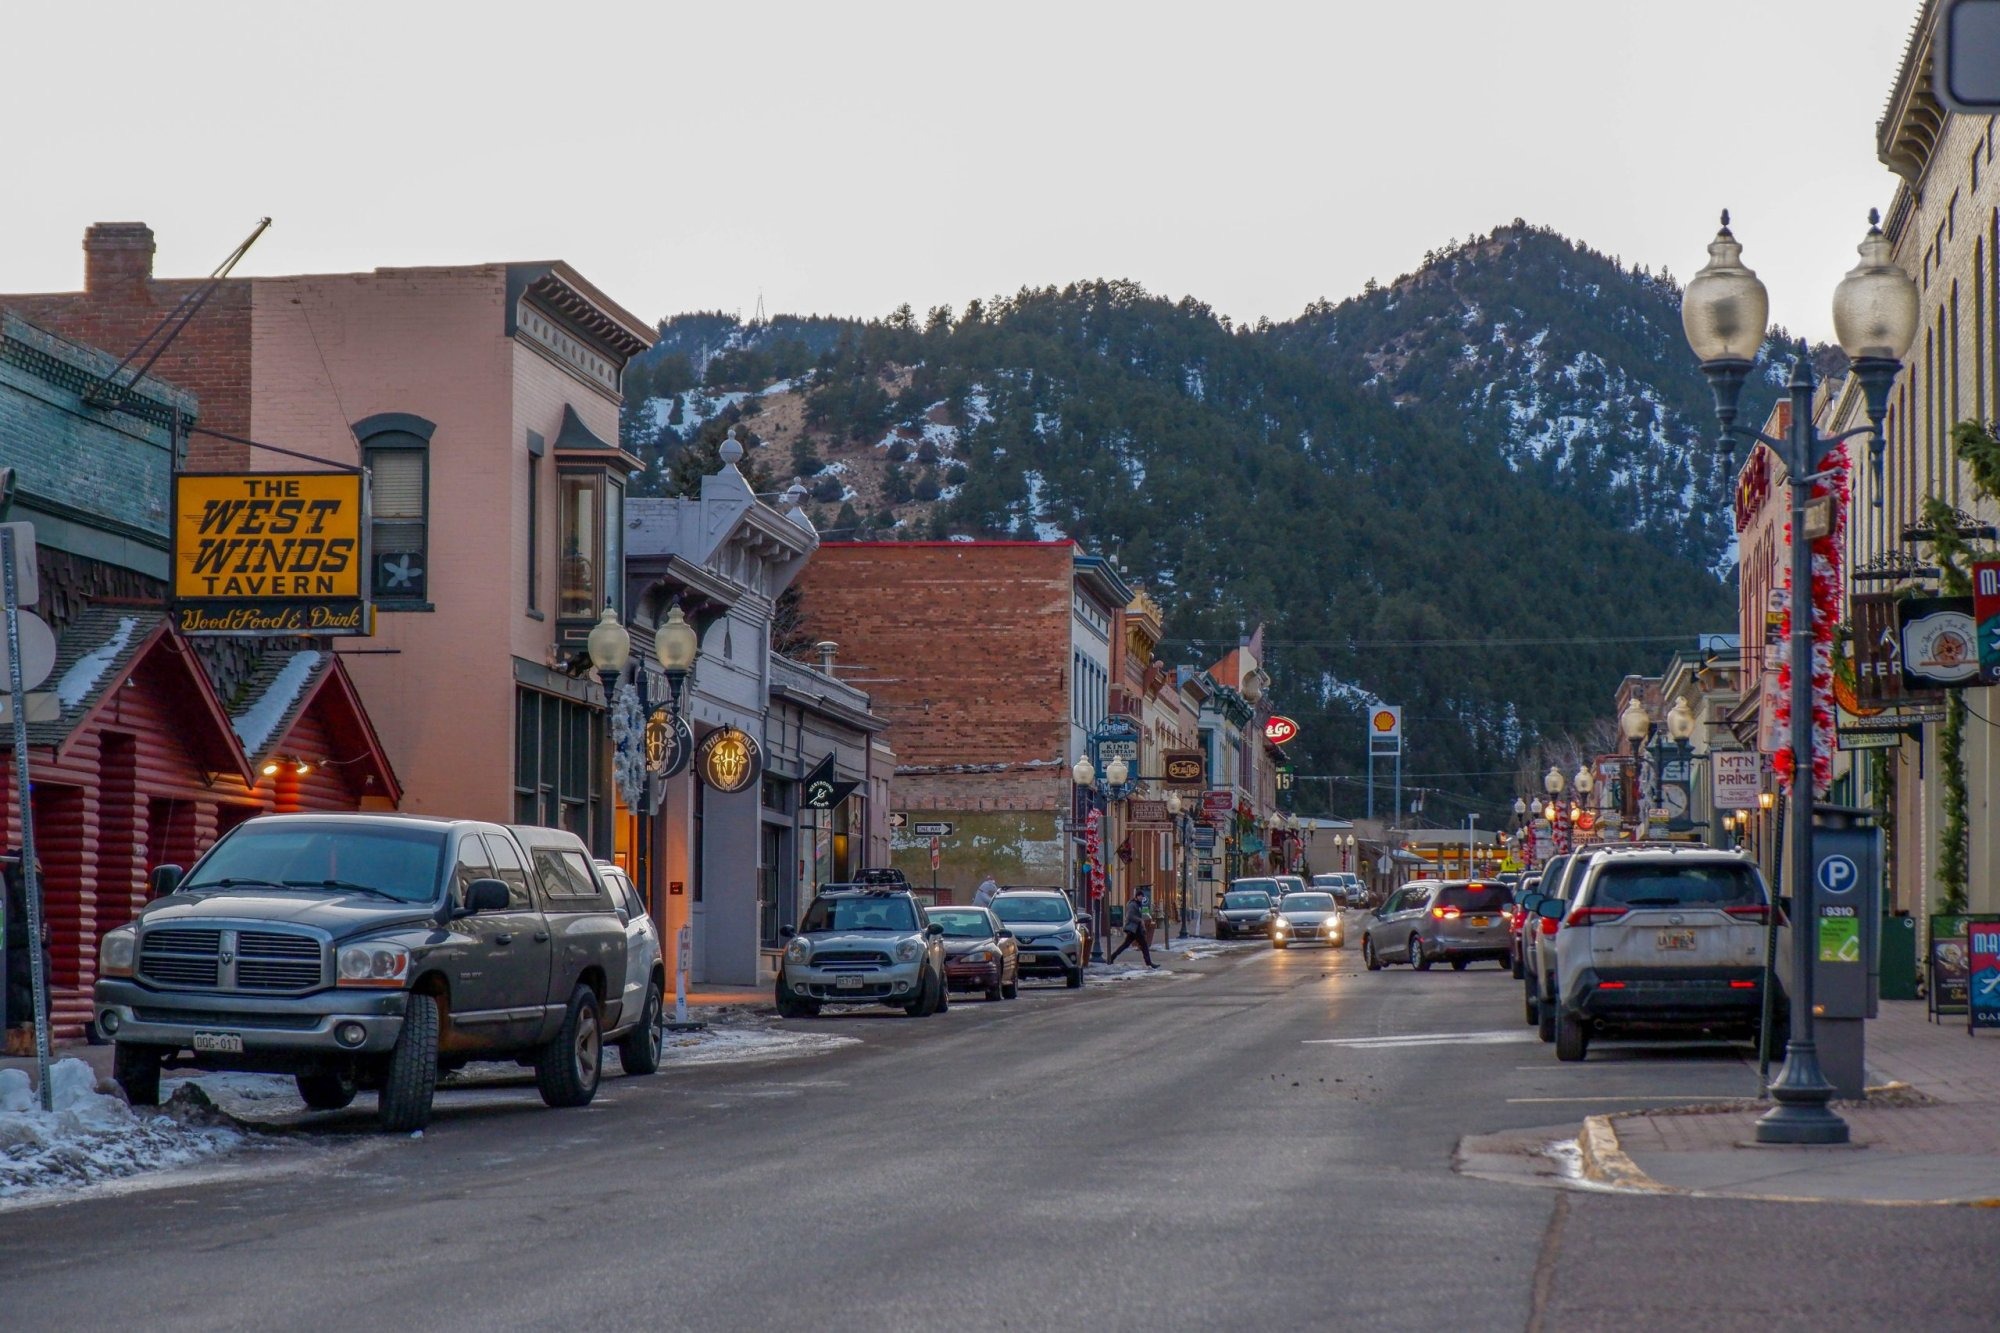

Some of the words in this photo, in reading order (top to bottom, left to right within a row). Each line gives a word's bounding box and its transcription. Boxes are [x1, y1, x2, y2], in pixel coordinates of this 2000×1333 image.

[243, 480, 300, 497] THE
[198, 499, 342, 534] WEST
[191, 538, 355, 574] WINDS
[201, 576, 334, 595] TAVERN
[1981, 568, 2000, 595] M
[181, 608, 234, 631] Good
[232, 607, 291, 630] Food
[288, 611, 302, 630] &
[310, 606, 361, 629] Drink
[1859, 716, 1899, 725] OUTDOOR
[1899, 714, 1923, 723] GEAR
[1923, 713, 1945, 721] SHOP
[701, 733, 721, 753] THE
[1720, 756, 1755, 768] MTN
[809, 780, 834, 793] WESTBOUND
[1718, 773, 1757, 785] PRIME
[1828, 861, 1850, 888] P
[1974, 933, 2000, 953] MA
